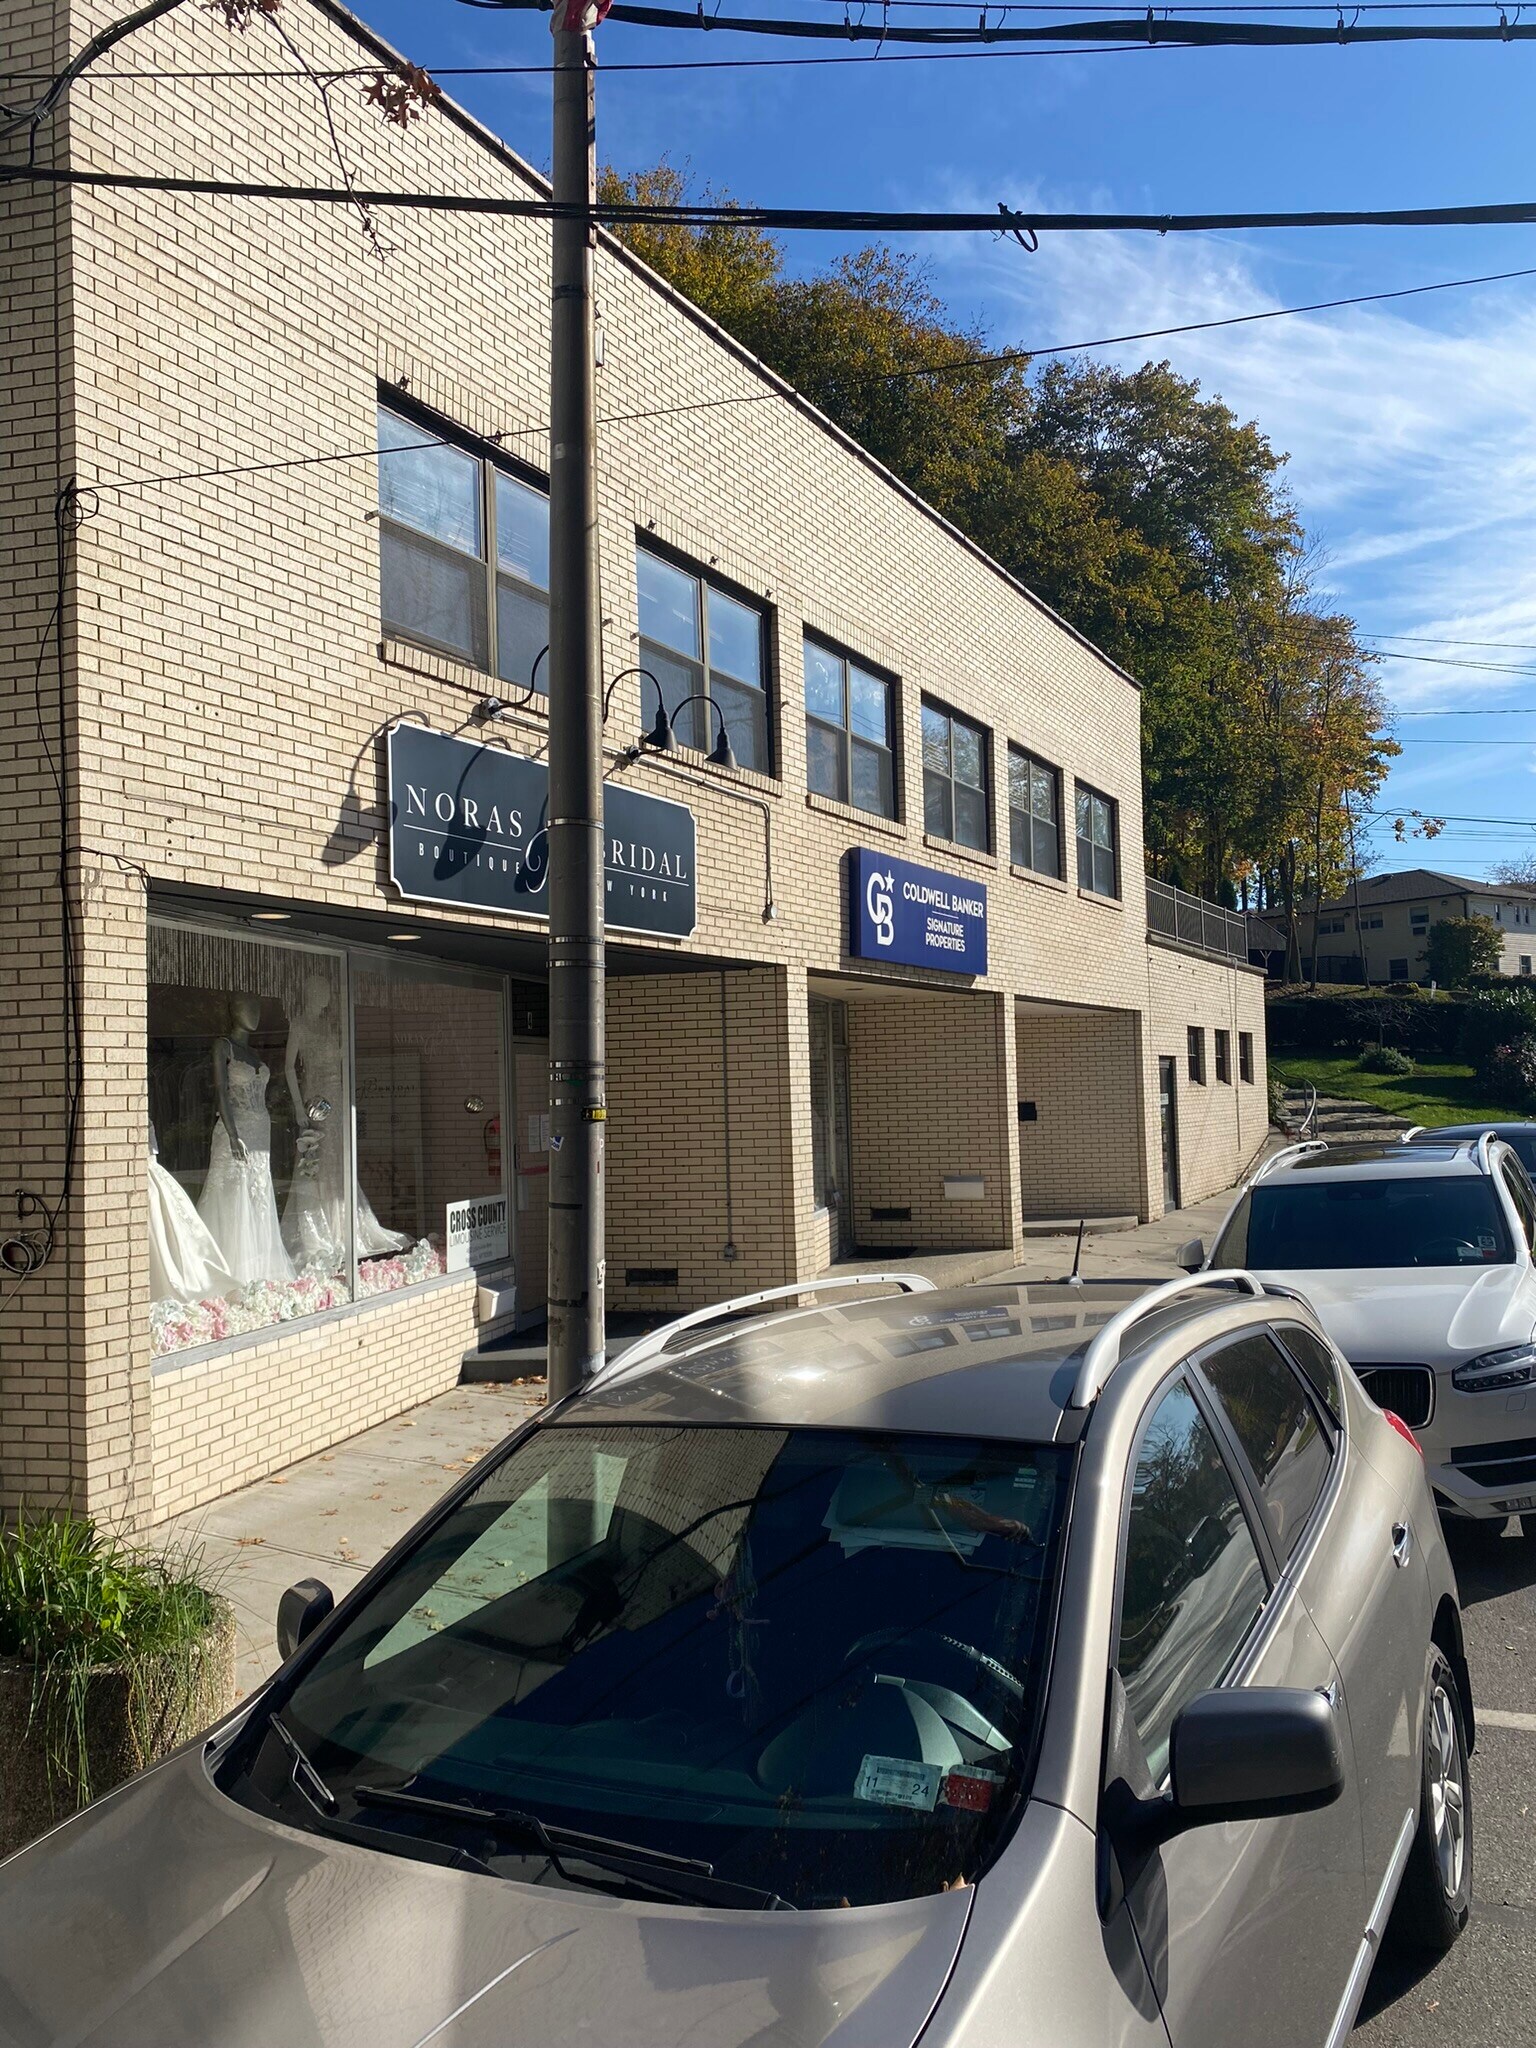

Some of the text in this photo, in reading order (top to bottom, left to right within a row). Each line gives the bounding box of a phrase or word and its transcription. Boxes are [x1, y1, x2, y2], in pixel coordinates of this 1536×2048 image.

[405, 783, 687, 879] NORAS RIDAL
[418, 842, 521, 875] BOUTIQUE
[629, 884, 668, 902] YORK
[902, 881, 984, 919] COLDWELL BANKER
[926, 917, 964, 937] SIGNATURE
[925, 932, 966, 952] PROPERTIES
[450, 1201, 507, 1234] CROSS COUNTY
[449, 1222, 507, 1247] LIMOUSINE SERVICE
[865, 1775, 878, 1788] 11
[911, 1783, 929, 1798] 24
